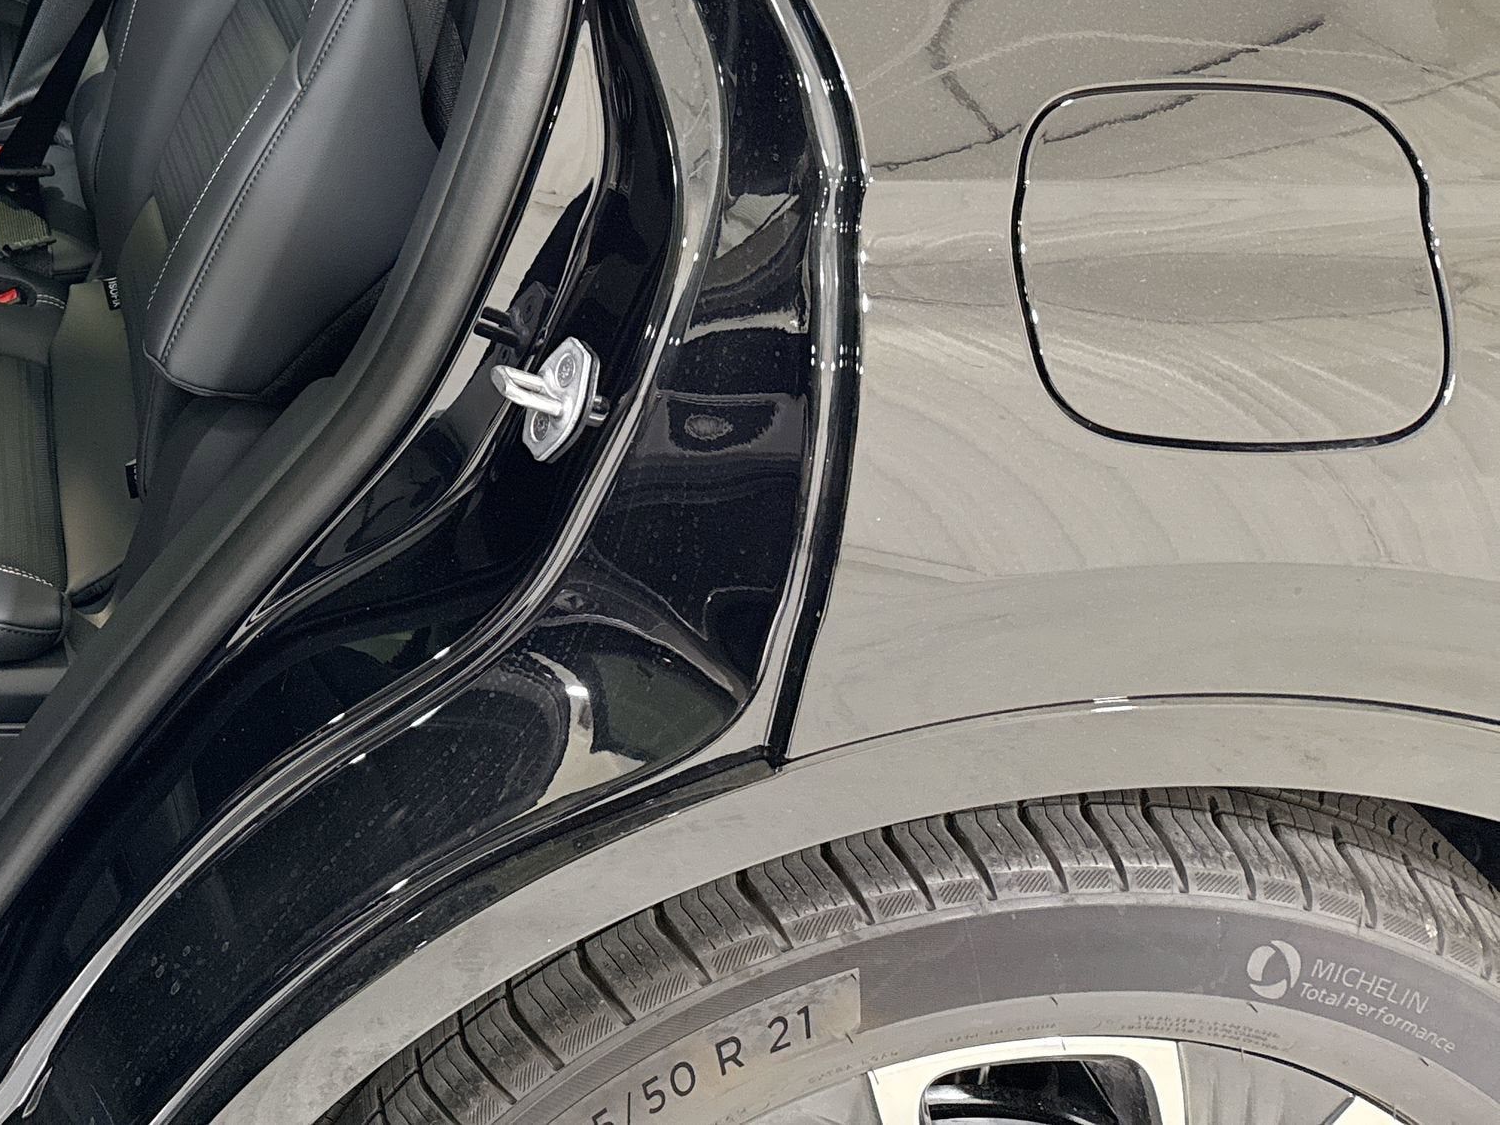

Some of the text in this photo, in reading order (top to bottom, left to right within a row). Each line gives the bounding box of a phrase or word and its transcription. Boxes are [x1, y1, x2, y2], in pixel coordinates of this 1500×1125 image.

[1300, 982, 1457, 1055] Total Performance
[1310, 958, 1430, 1015] MICHELIN
[715, 1035, 746, 1076] R
[767, 1005, 812, 1054] 21
